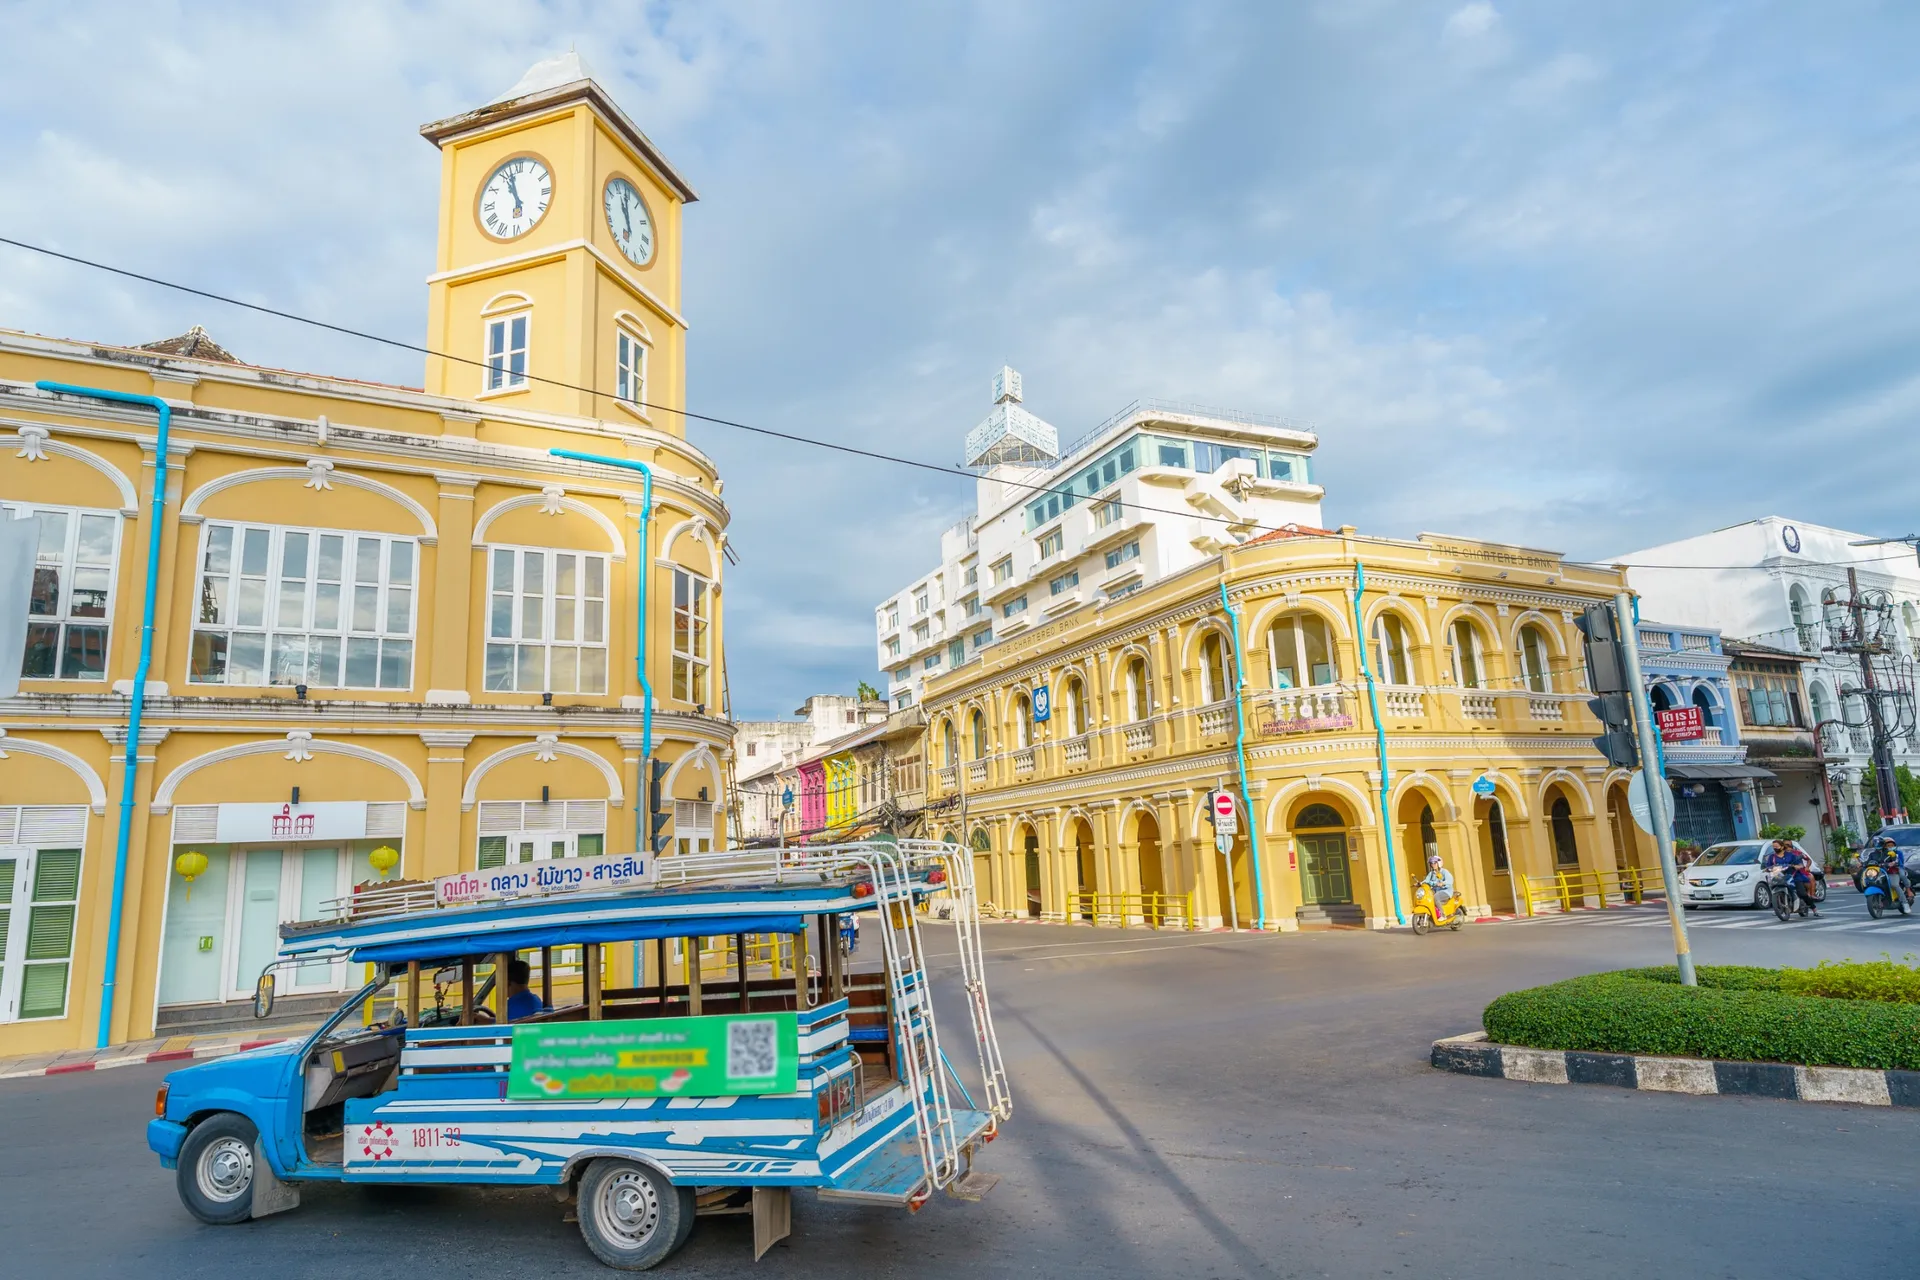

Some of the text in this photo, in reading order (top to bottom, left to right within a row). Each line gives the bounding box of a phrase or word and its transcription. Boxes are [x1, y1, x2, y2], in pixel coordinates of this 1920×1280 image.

[1437, 544, 1553, 569] THE CHARTERED BANK
[998, 617, 1080, 656] THE CHARTERED BANK
[443, 857, 644, 902] ภูเก็ต ถลาง ไม้ขาว สารสิน
[564, 883, 580, 891] Beach
[411, 1127, 461, 1148] 1811-33
